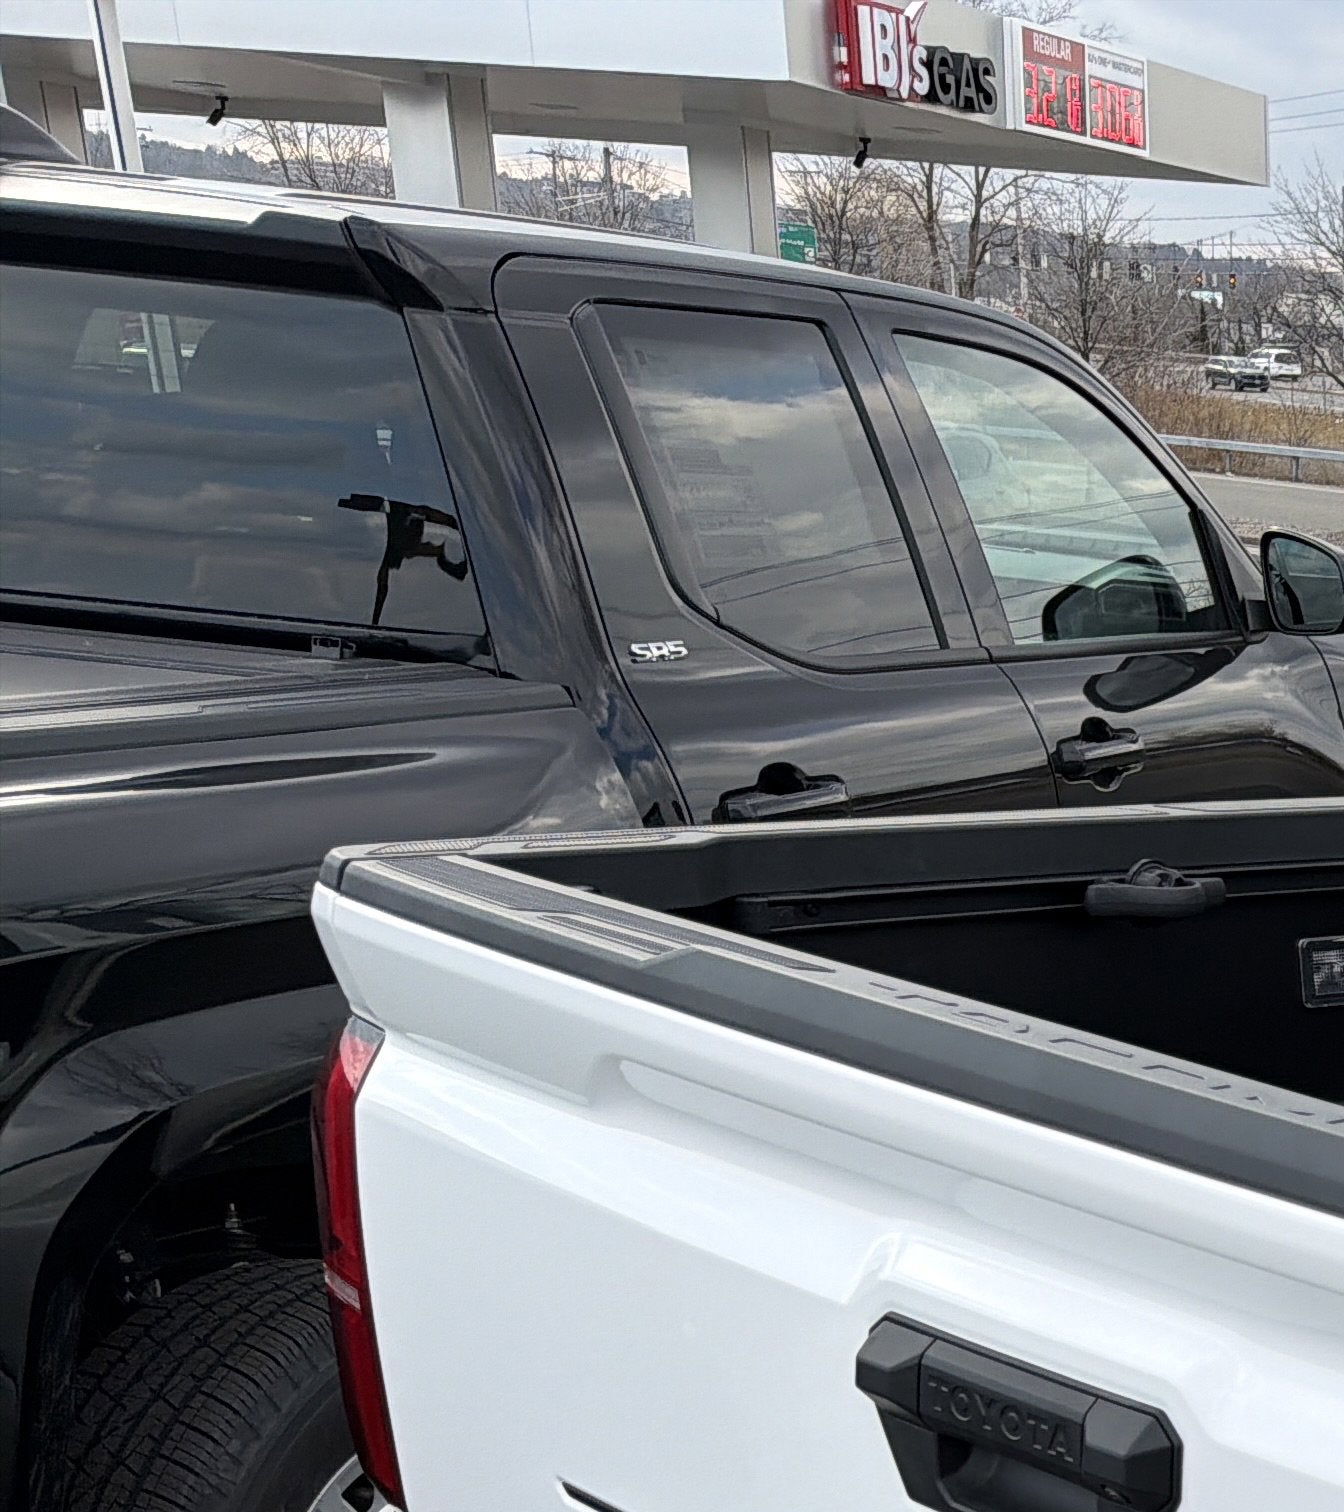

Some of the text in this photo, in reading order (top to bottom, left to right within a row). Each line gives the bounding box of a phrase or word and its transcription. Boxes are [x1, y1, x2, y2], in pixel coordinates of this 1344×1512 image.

[1032, 32, 1073, 62] REGULAR
[933, 49, 998, 115] GAS
[631, 640, 689, 662] SR5
[927, 1374, 1075, 1463] TOYOTA
